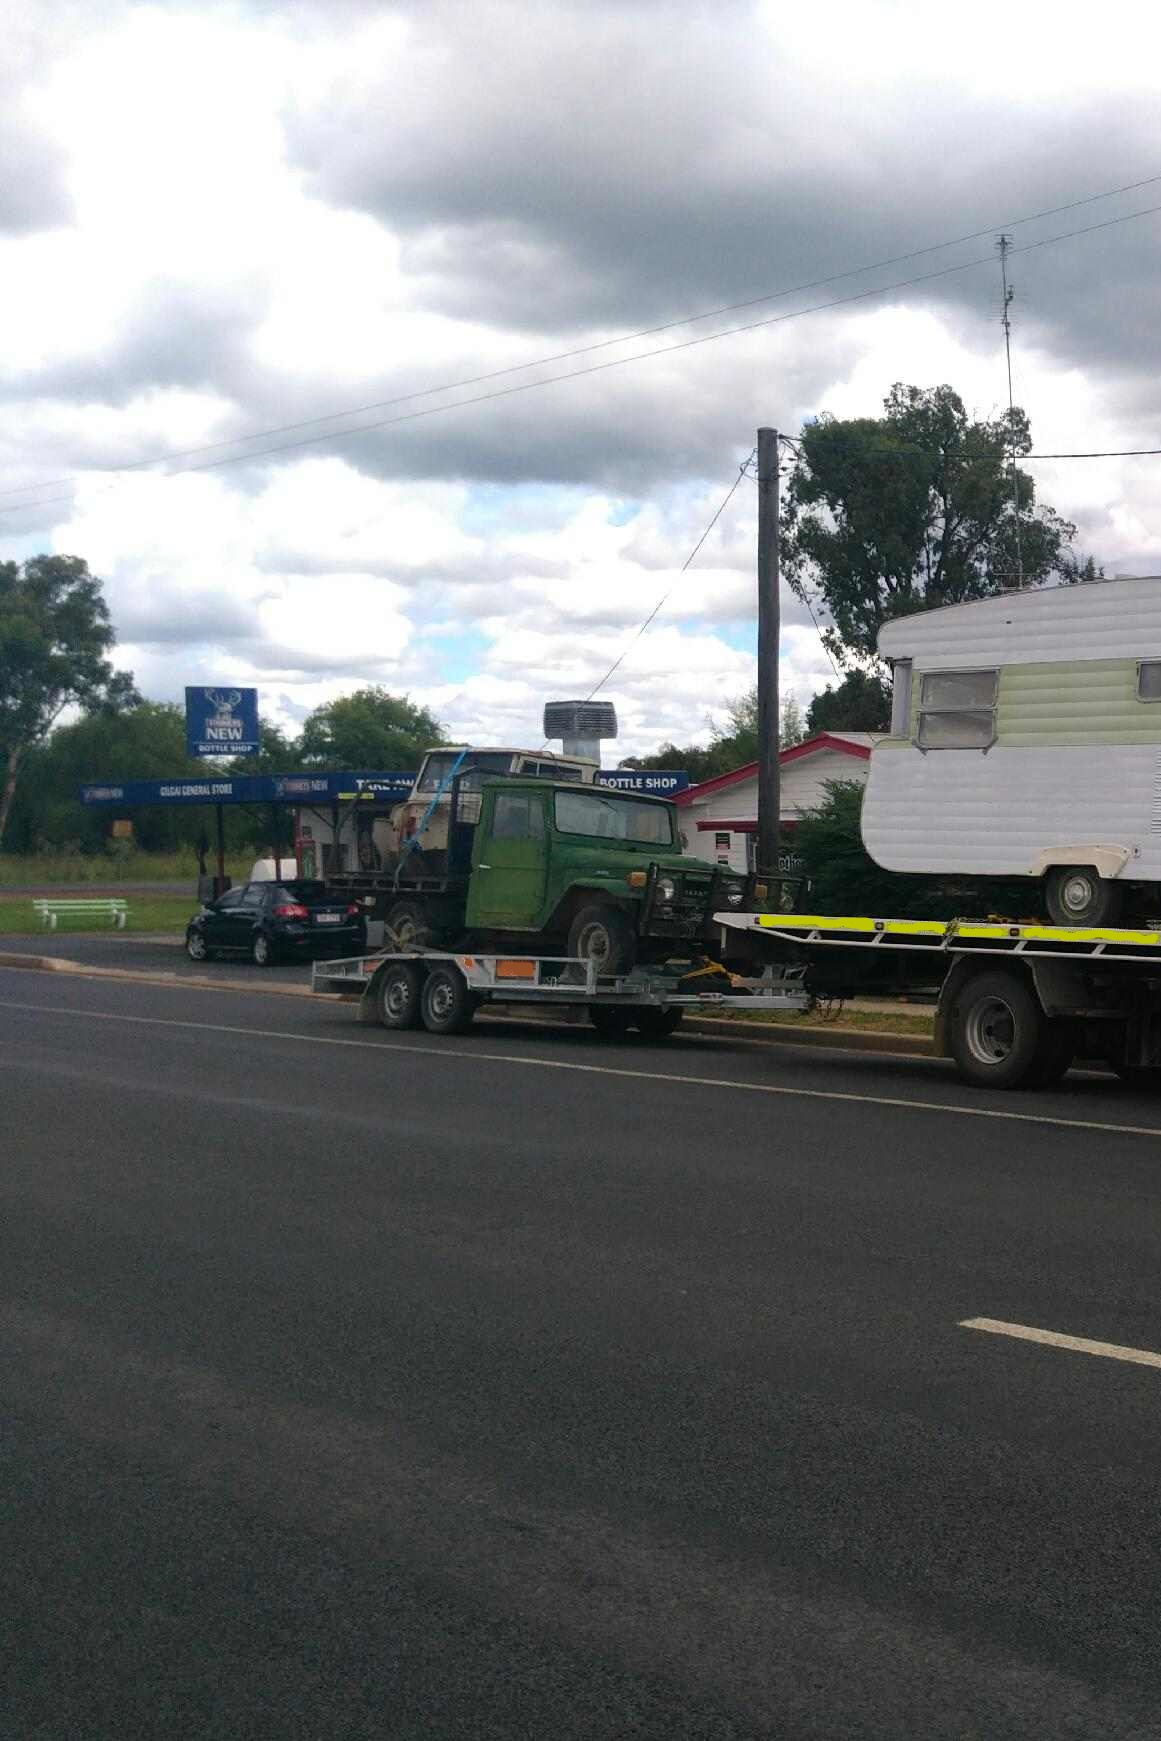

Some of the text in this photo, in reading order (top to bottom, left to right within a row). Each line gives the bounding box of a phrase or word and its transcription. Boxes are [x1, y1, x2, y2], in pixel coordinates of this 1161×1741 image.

[206, 727, 243, 740] NEW
[198, 744, 253, 753] BOTTLE SHOP
[182, 785, 211, 796] GENERAL
[211, 783, 233, 795] STORE
[599, 778, 678, 789] BOTTLE SHOP
